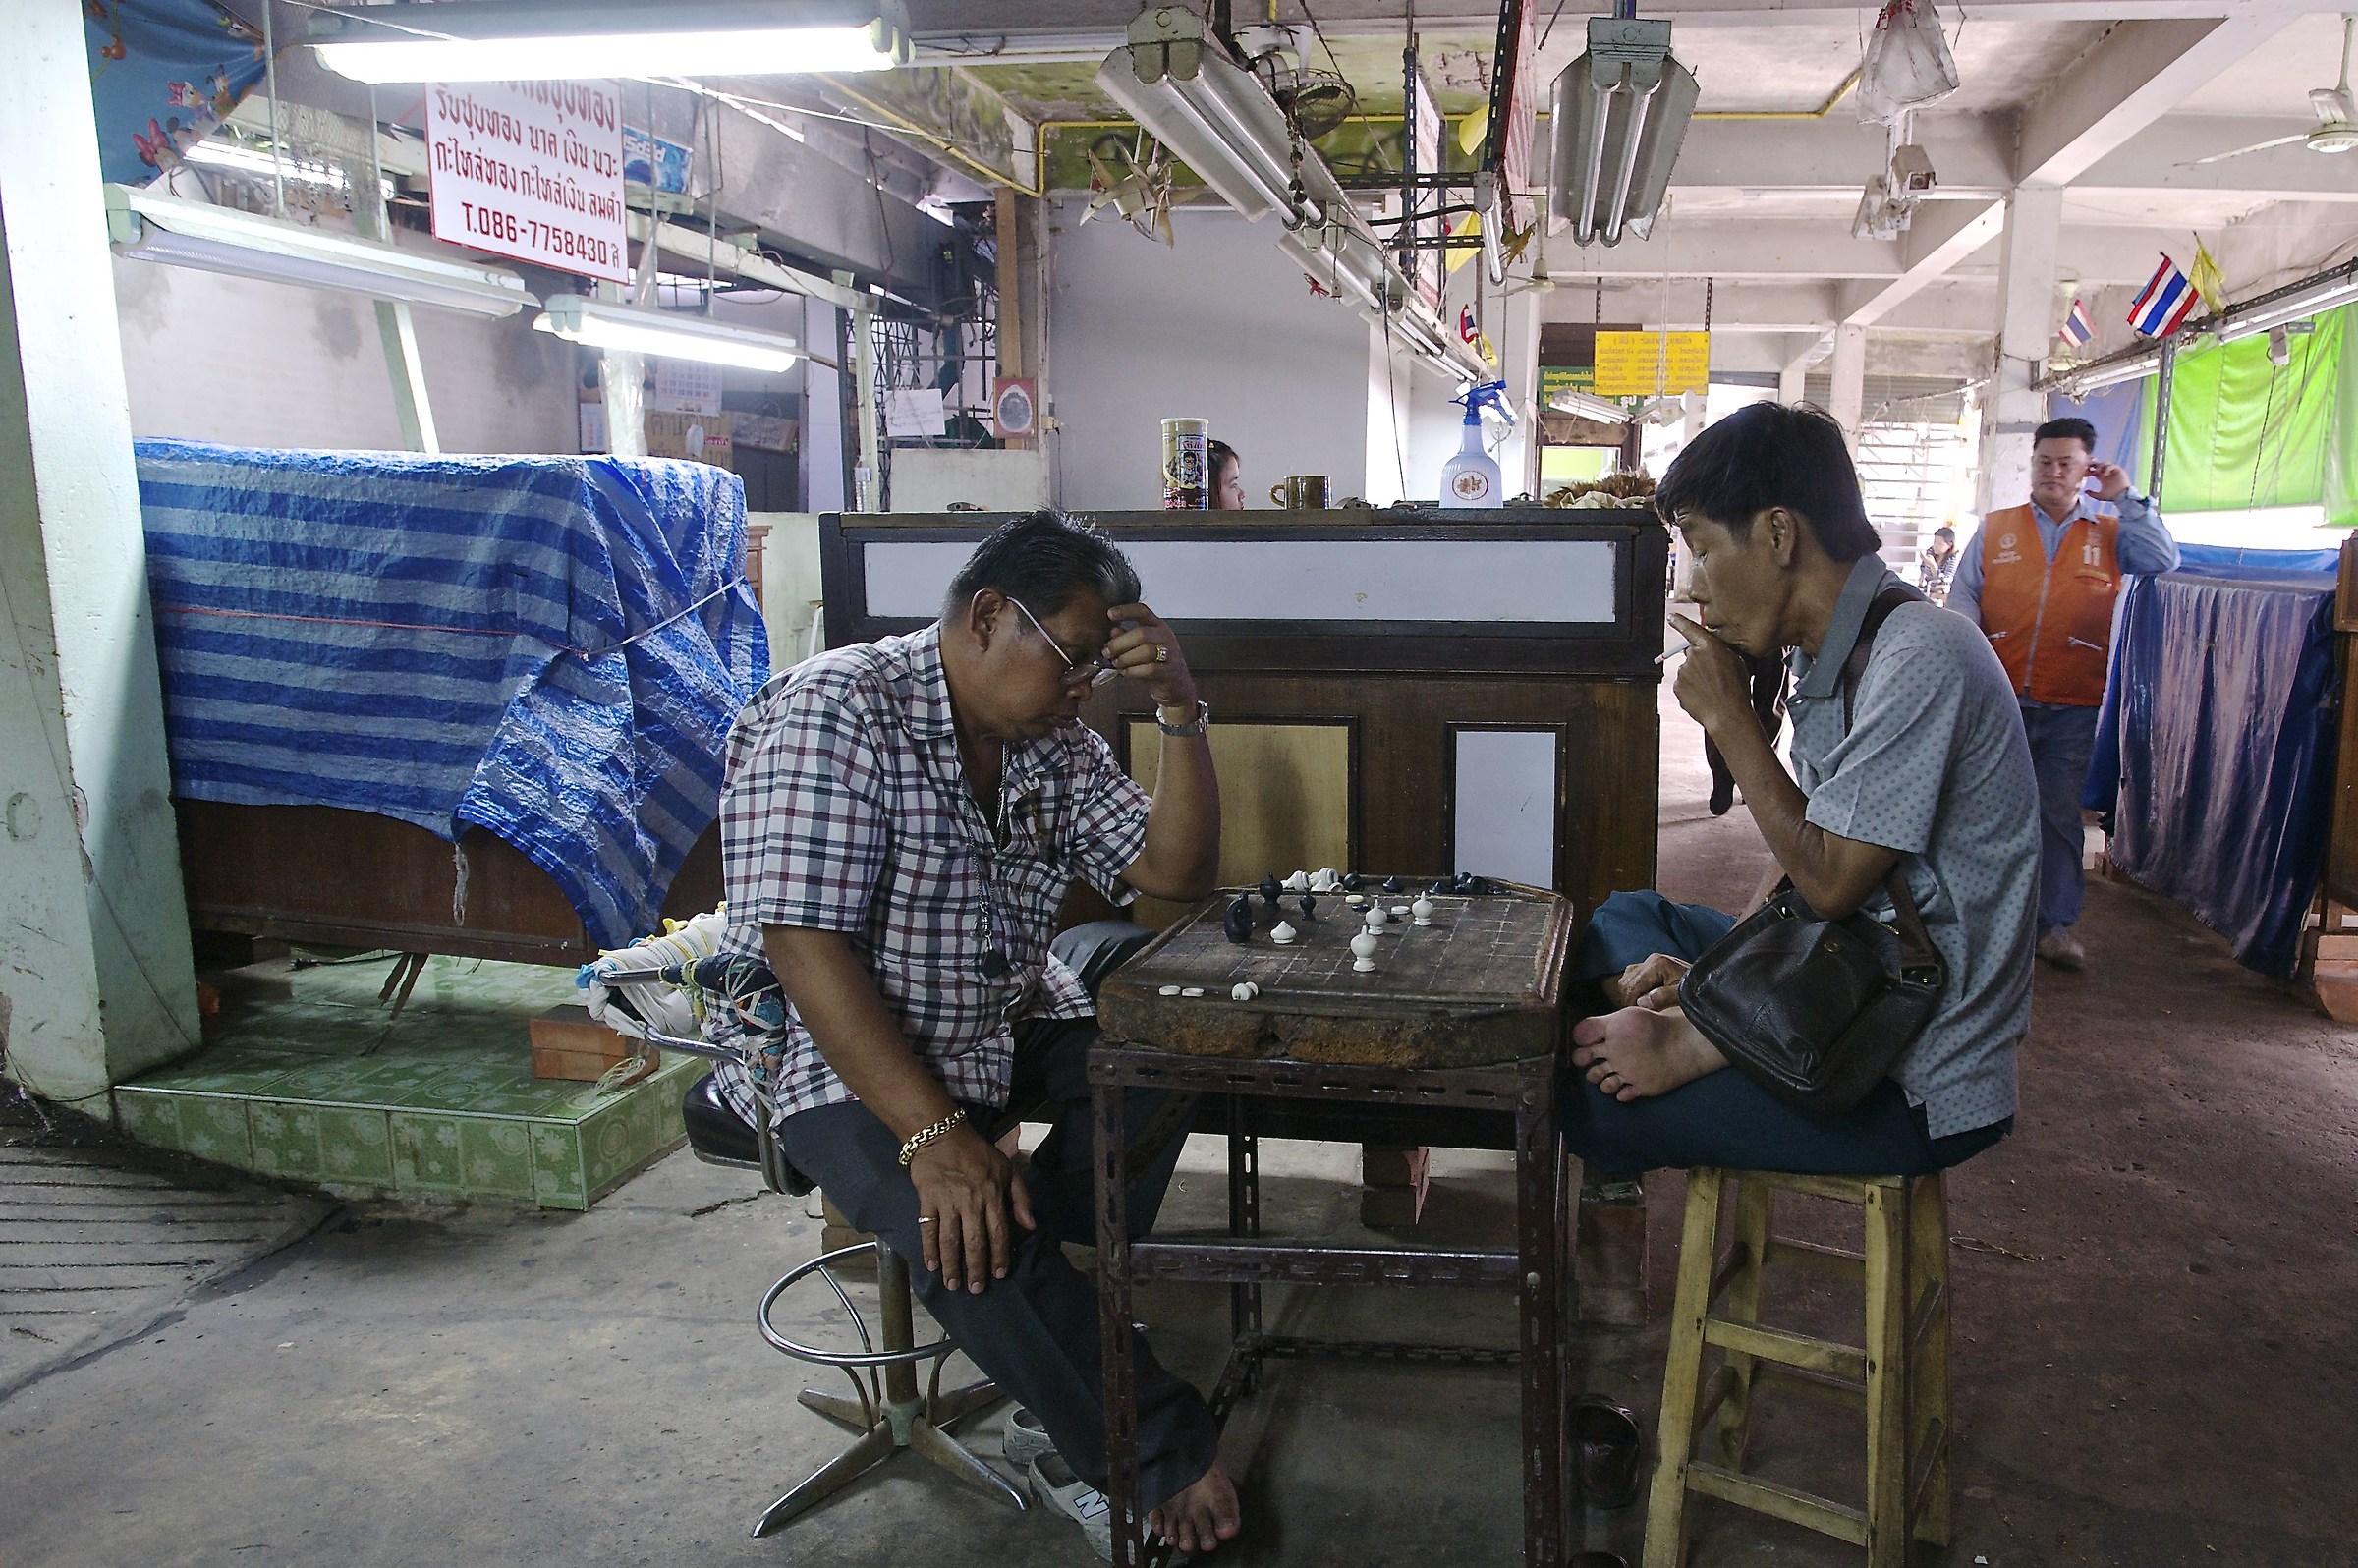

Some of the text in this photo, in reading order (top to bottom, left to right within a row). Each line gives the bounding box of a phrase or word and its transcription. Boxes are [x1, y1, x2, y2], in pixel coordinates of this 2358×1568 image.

[435, 136, 517, 193] กะไหล่ทอง
[520, 164, 586, 214] กะไหล่เงิน
[528, 125, 558, 159] นาค
[564, 128, 588, 170] เงิน
[593, 148, 618, 178] นวะ
[461, 201, 607, 265] T.086-7758430
